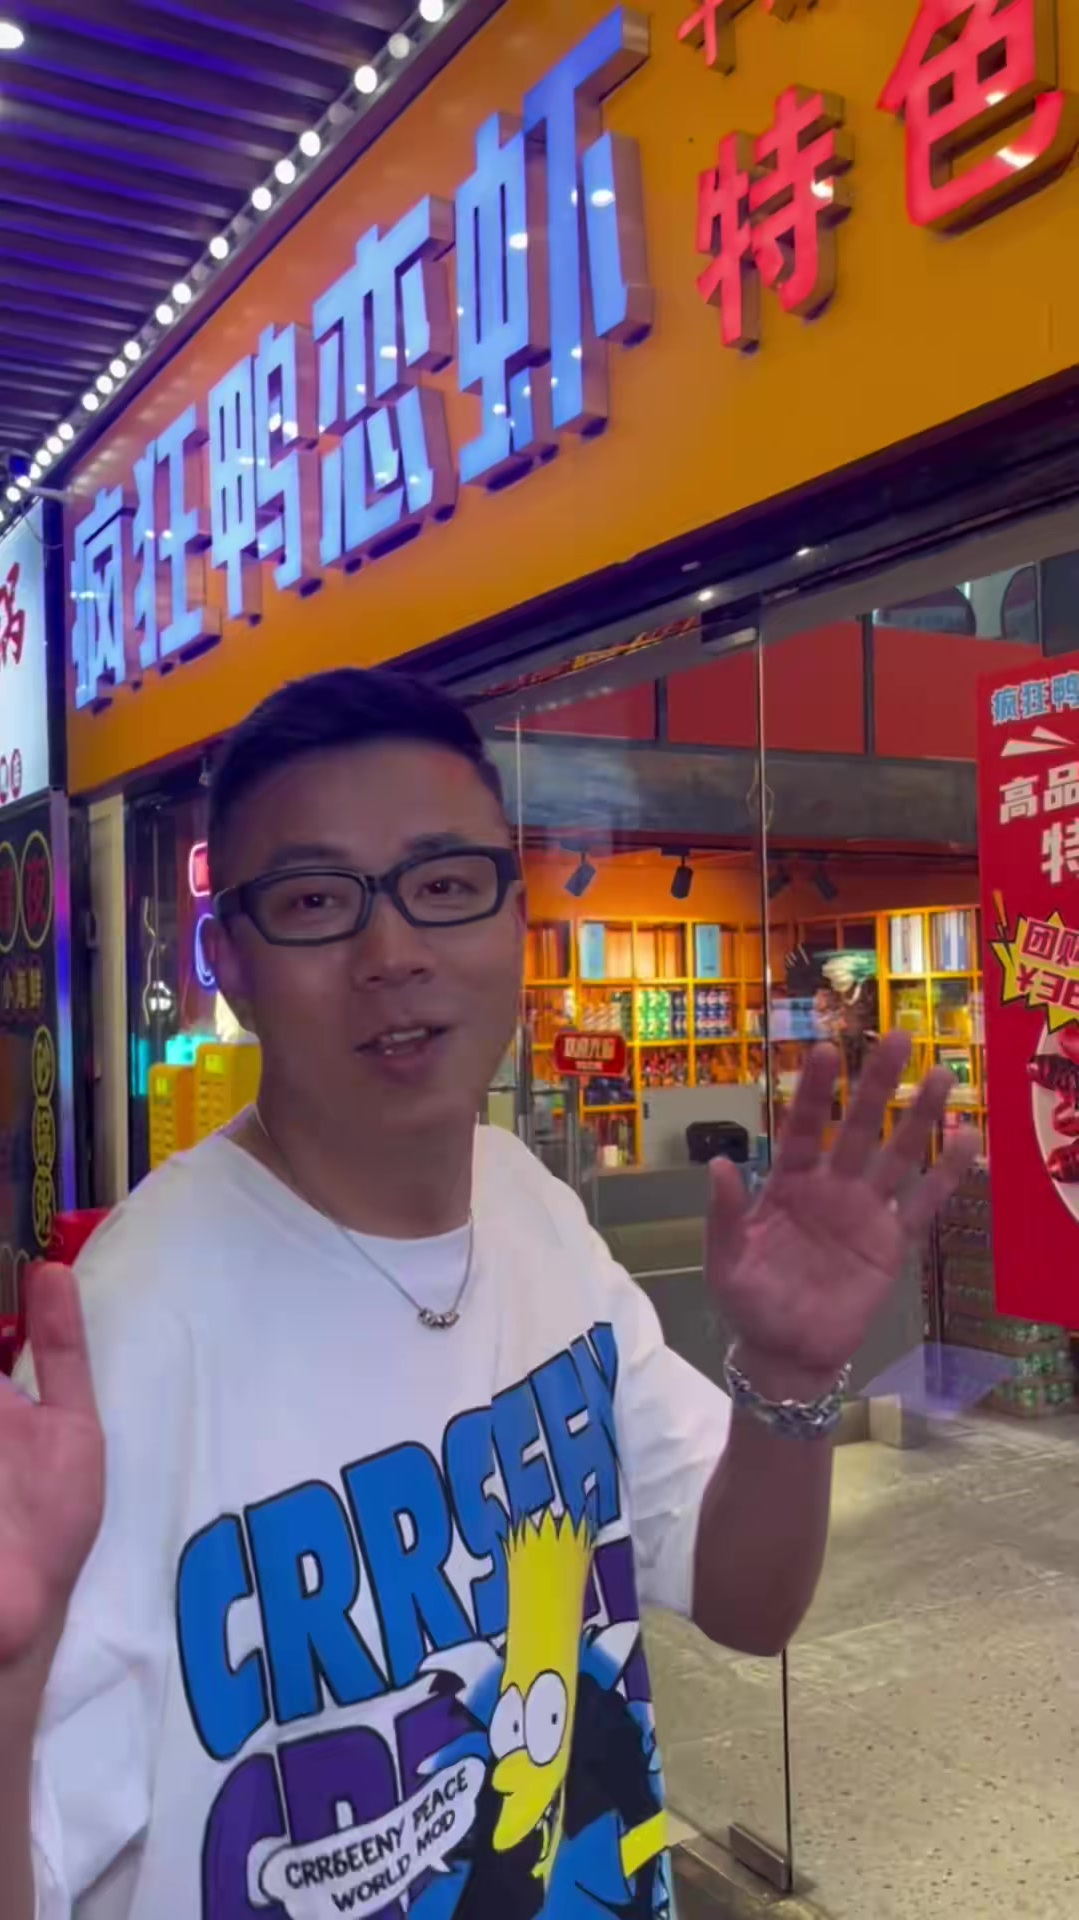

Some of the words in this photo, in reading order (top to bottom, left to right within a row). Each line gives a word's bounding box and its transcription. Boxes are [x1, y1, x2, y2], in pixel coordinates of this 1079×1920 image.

[696, 0, 1065, 349] 特色
[71, 5, 630, 709] 疯狂鸭恋虾
[999, 761, 1079, 825] 高品
[412, 1766, 469, 1832] PEACE
[331, 1853, 411, 1912] WORLD
[416, 1808, 456, 1857] MOD
